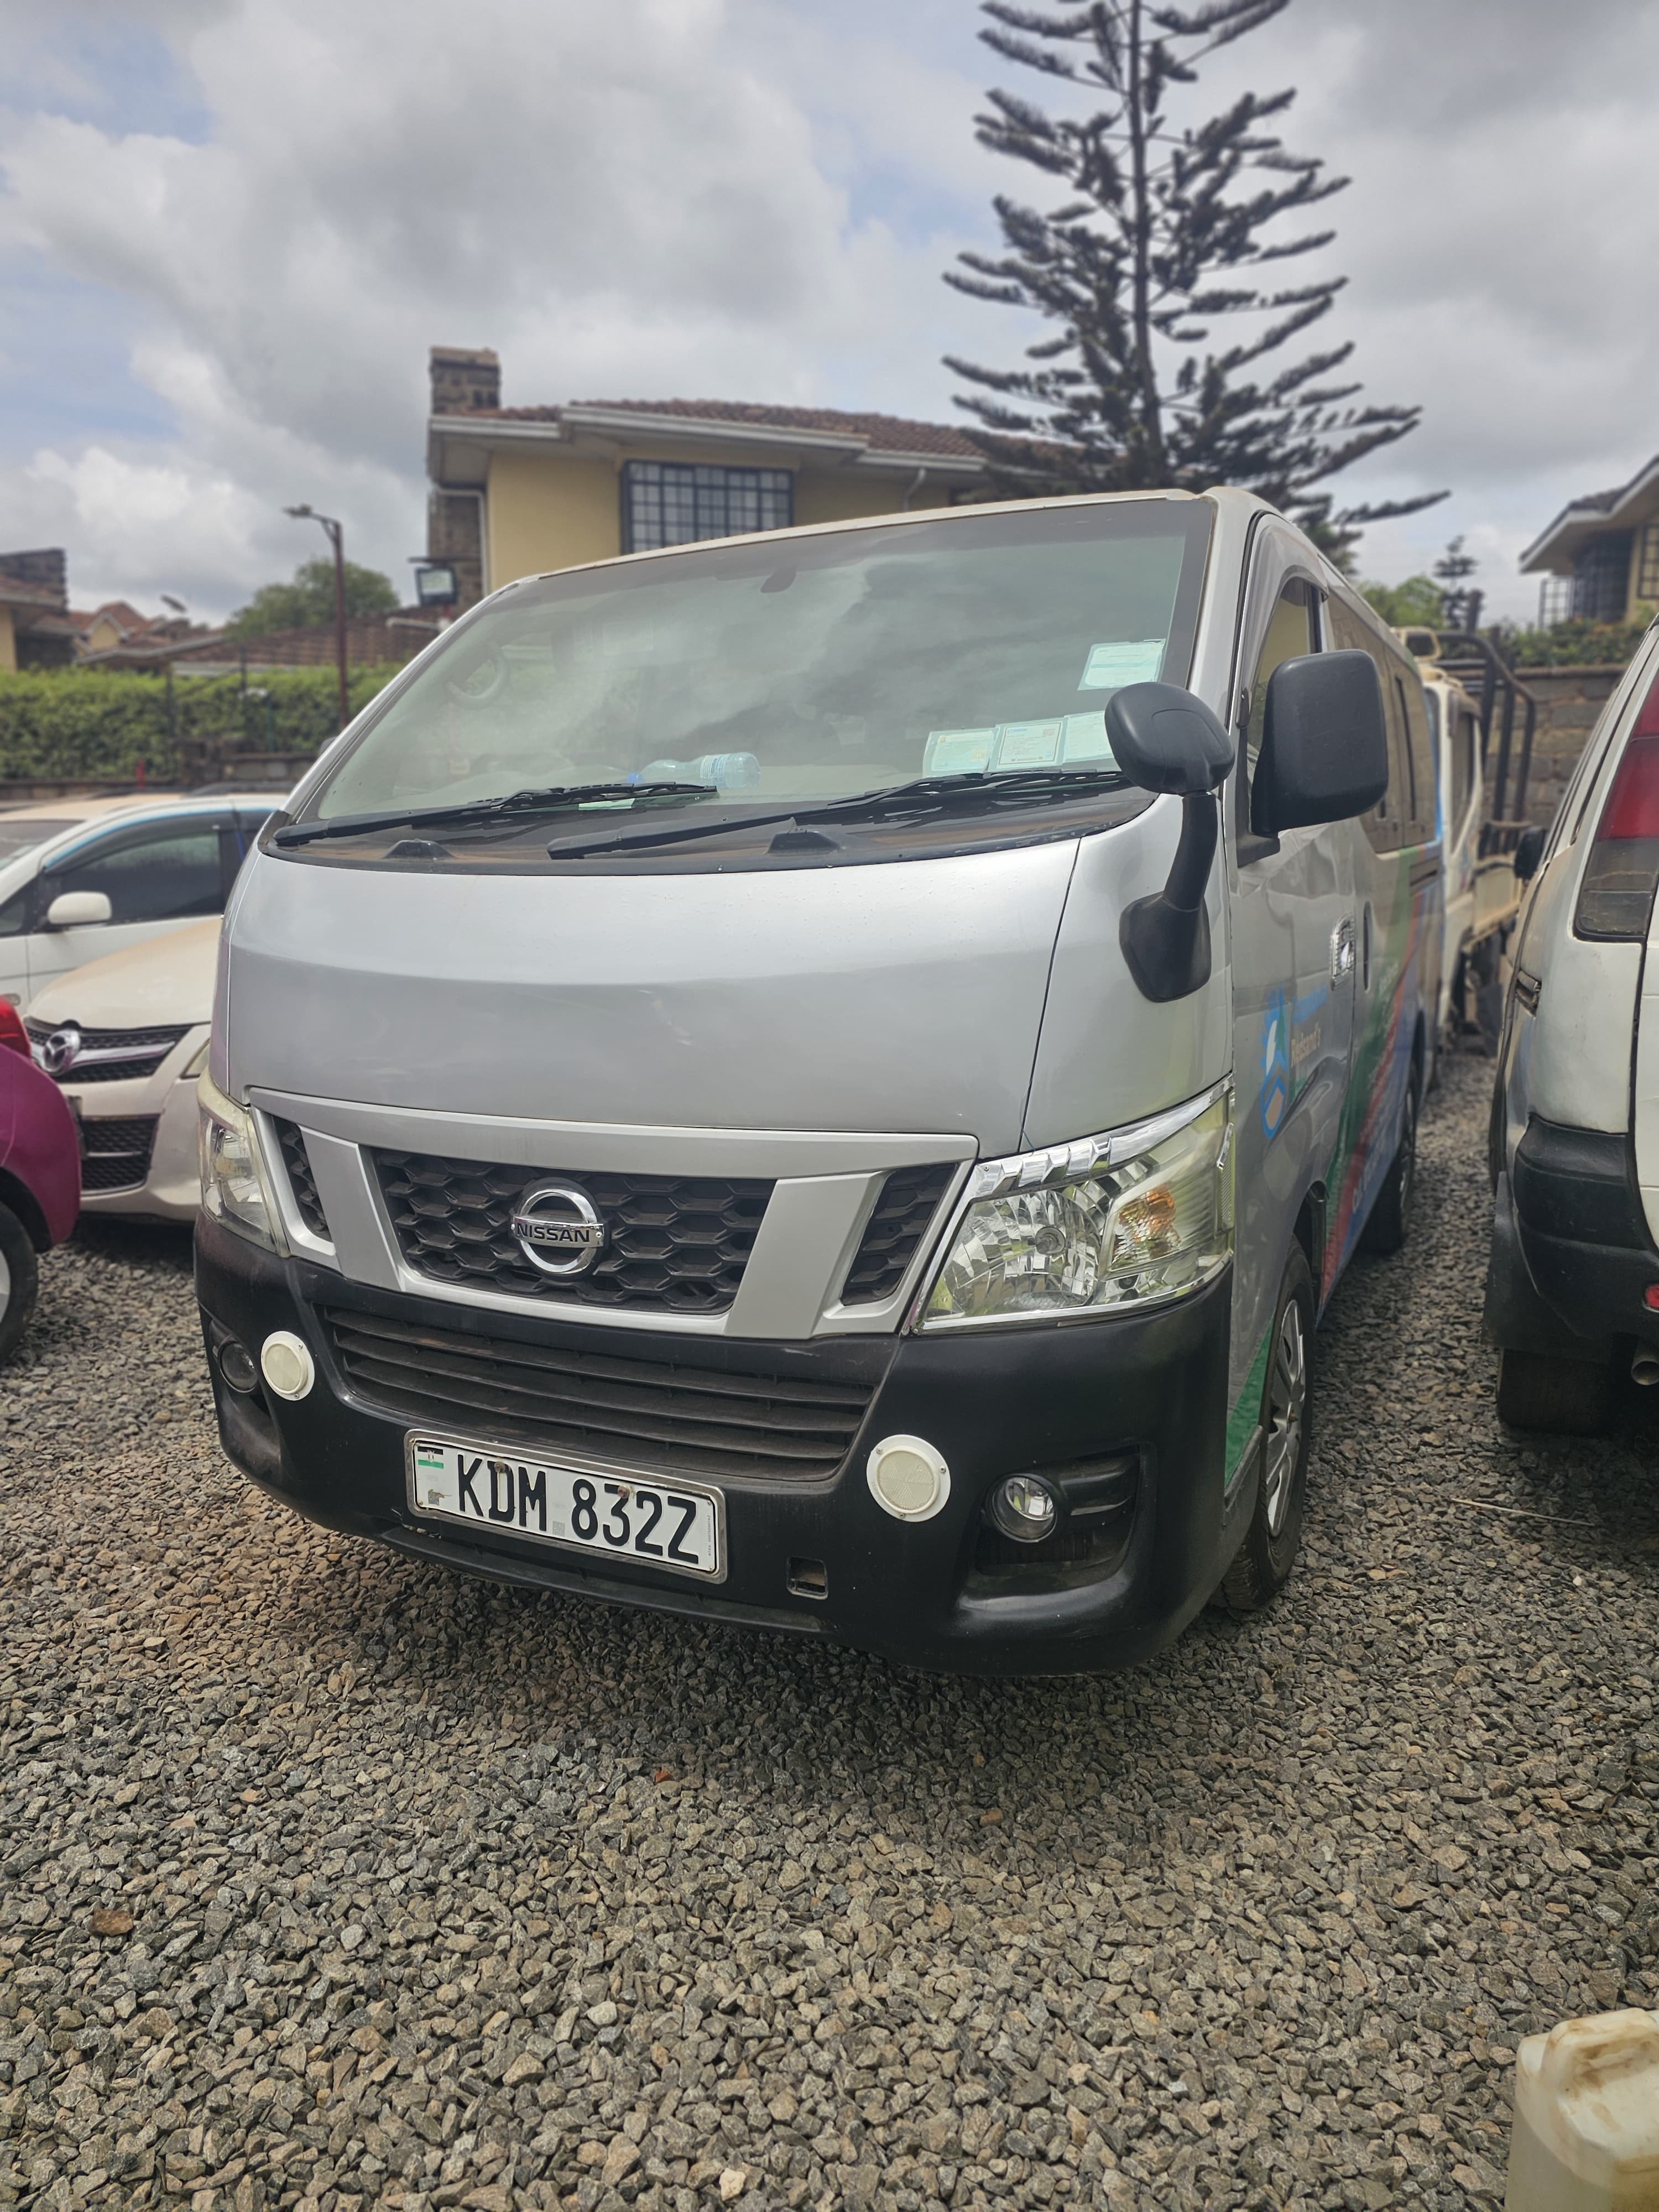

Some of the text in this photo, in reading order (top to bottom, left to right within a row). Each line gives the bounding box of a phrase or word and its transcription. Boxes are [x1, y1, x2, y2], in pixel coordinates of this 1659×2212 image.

[517, 1223, 590, 1243] NISSAN
[457, 1454, 547, 1531] KDM
[571, 1478, 699, 1564] 832Z
